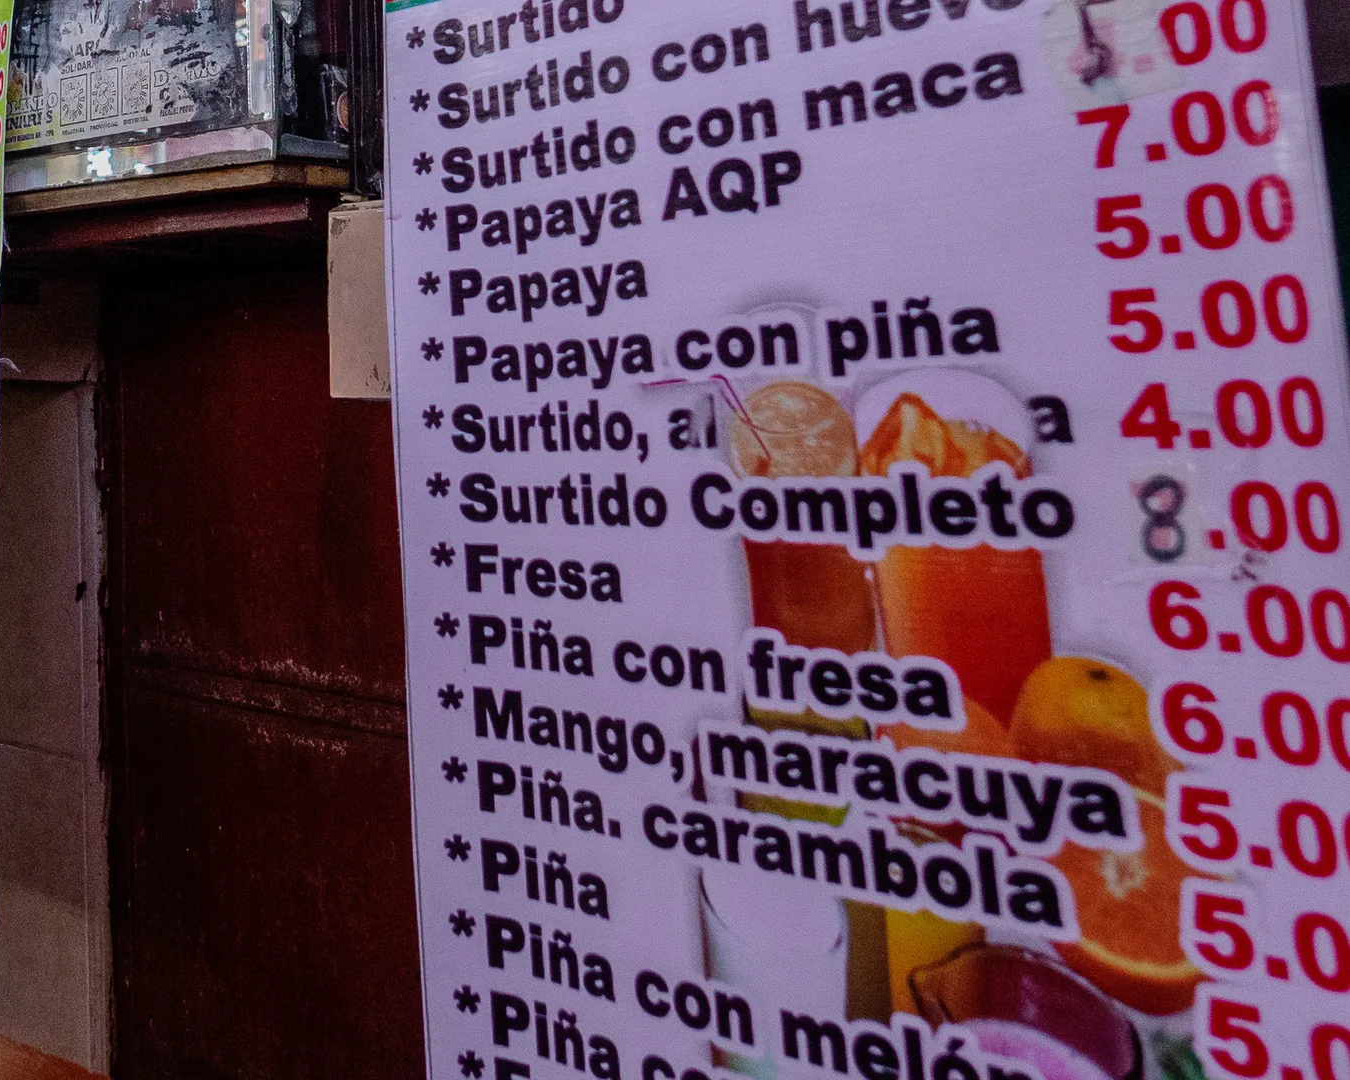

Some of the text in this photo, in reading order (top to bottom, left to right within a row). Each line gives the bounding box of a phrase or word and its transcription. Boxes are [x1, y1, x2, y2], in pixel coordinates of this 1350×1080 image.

[438, 51, 630, 129] Surtido
[652, 23, 769, 82] con
[442, 119, 635, 193] Surtido
[659, 99, 777, 154] con
[805, 52, 1023, 130] maca
[446, 79, 1278, 254] Papaya AQP 7.00
[449, 174, 1295, 322] Papaya 5.00
[454, 273, 1311, 392] Papaya con piña 5.00
[452, 400, 648, 463] Surtido,
[1119, 376, 1325, 450] 4.00
[460, 473, 667, 527] Surtido
[691, 474, 1074, 551] Completo
[465, 544, 1350, 663] Fresa 6.00
[469, 615, 593, 676] Piña
[614, 641, 725, 693] con
[749, 640, 951, 718] fresa
[473, 687, 1350, 877] Mango, maracuya 5.0
[481, 839, 609, 920] Piña
[643, 790, 1063, 927] carambola
[485, 915, 615, 1002] Piña
[636, 971, 754, 1045] con
[490, 991, 621, 1080] Piña
